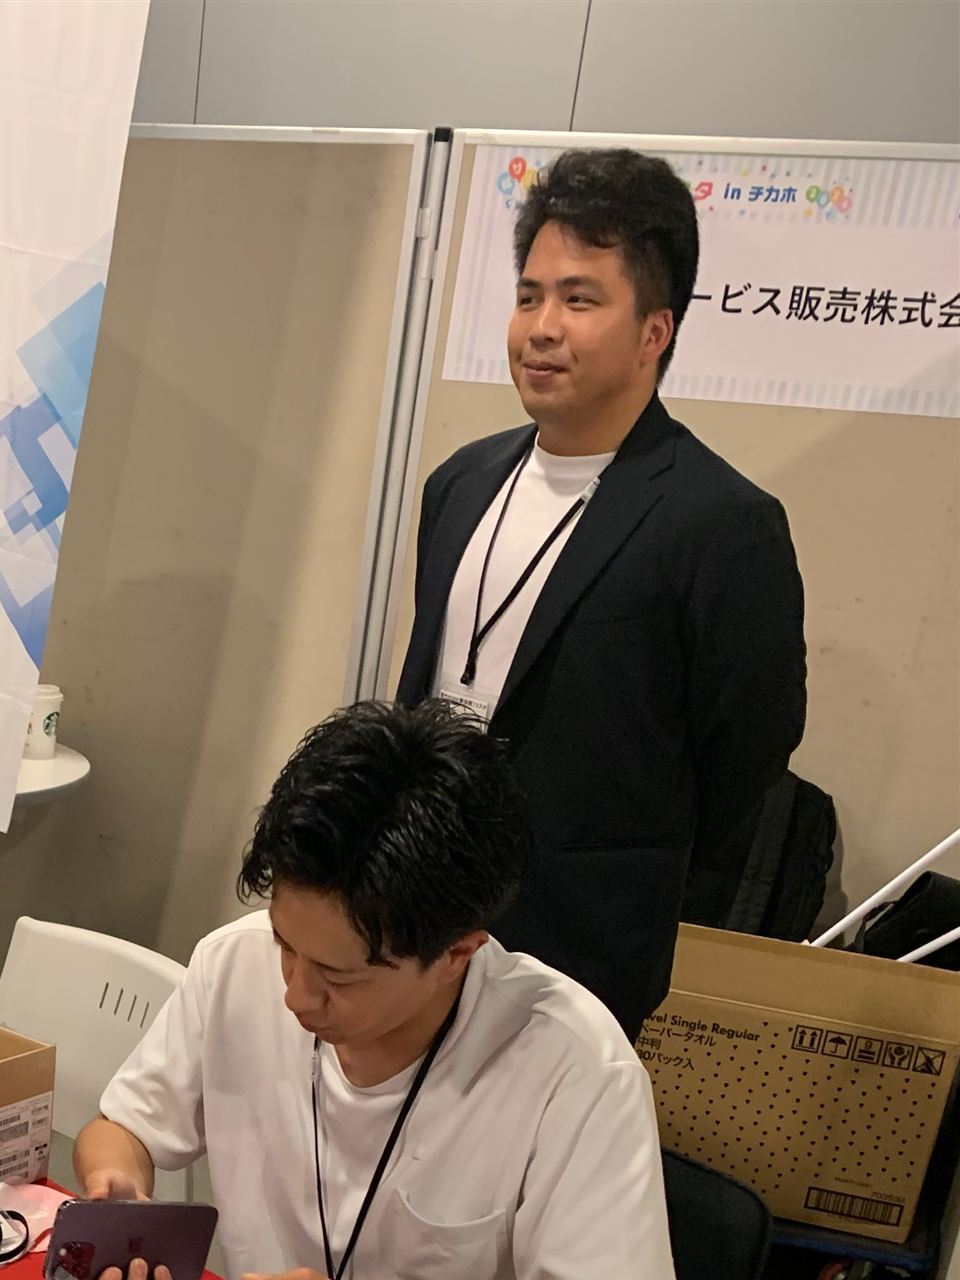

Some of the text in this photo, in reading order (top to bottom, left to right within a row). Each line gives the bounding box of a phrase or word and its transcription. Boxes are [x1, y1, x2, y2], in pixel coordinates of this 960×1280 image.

[724, 183, 742, 201] in
[748, 185, 798, 204] チカホ
[671, 1014, 708, 1032] Single
[711, 1022, 760, 1042] Regular
